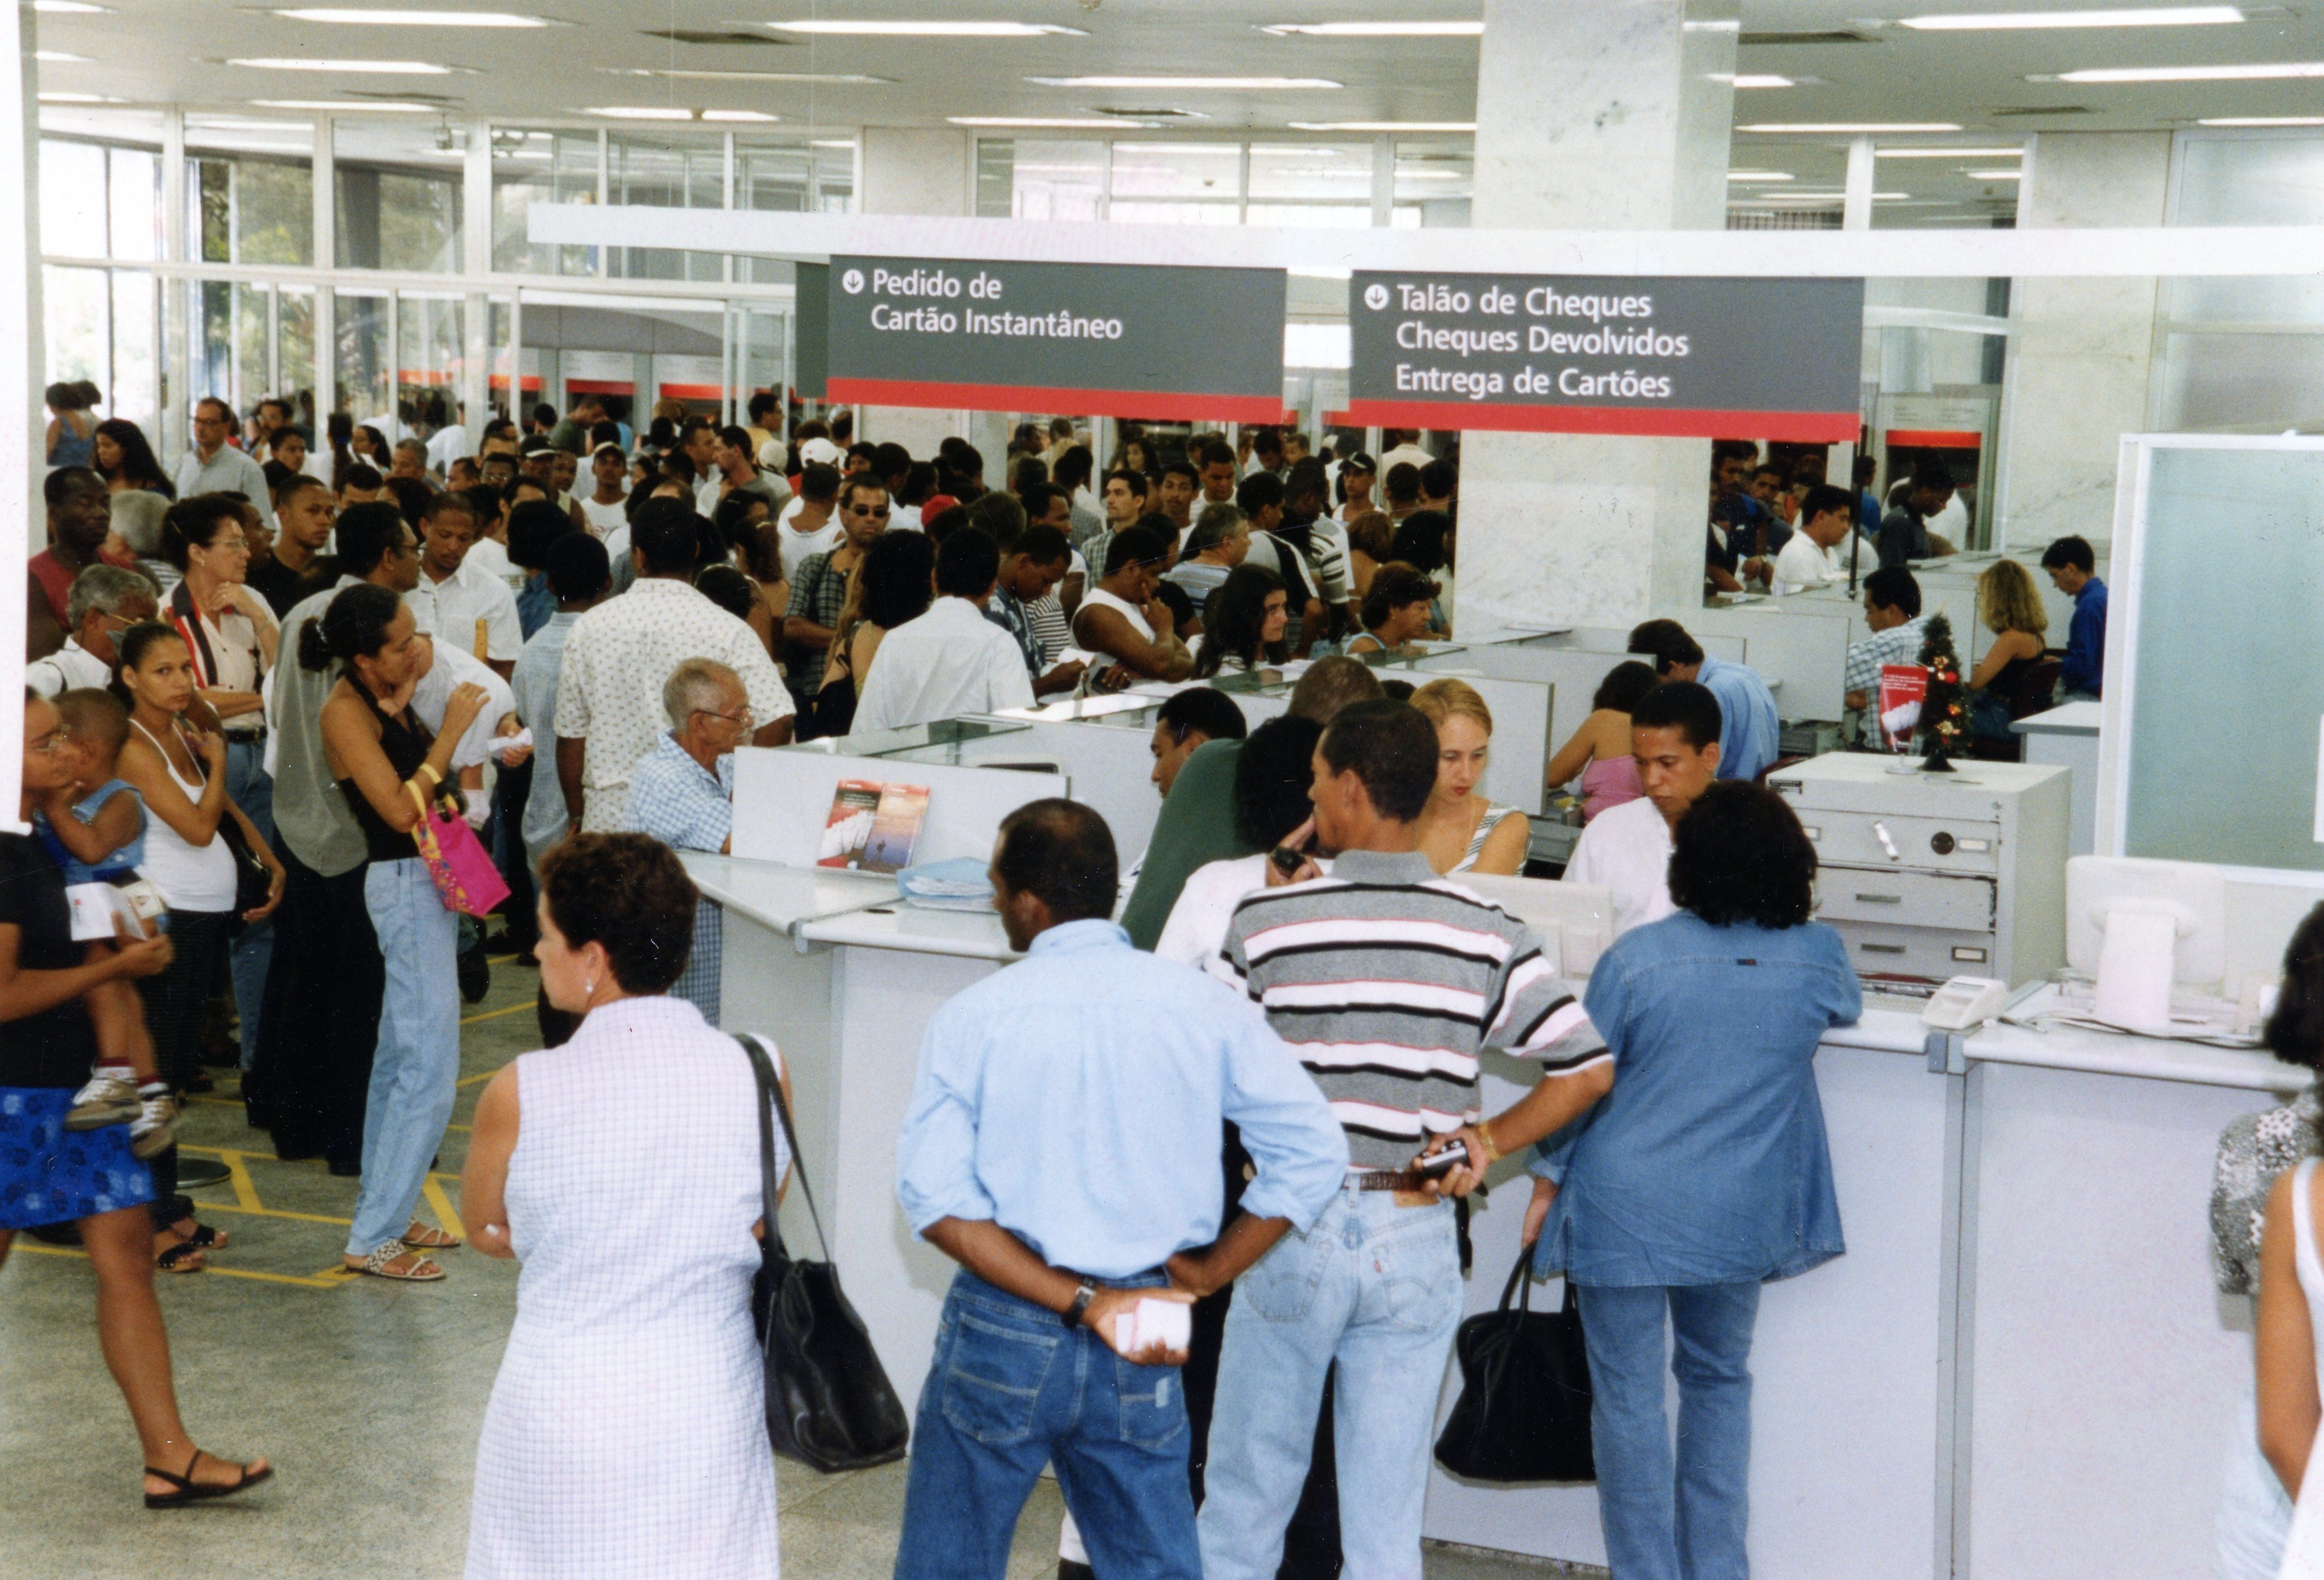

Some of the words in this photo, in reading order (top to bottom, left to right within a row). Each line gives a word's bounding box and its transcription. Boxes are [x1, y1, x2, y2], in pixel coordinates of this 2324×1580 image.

[873, 268, 961, 297] Pedido
[969, 272, 1002, 299] de
[871, 304, 957, 333] Cartão
[967, 309, 1123, 339] Instantâneo
[1397, 283, 1471, 313] Talão
[1480, 285, 1517, 315] de
[1525, 287, 1652, 323] Cheques
[1396, 320, 1519, 357] Cheques
[1529, 326, 1690, 357] Devolvidos
[1396, 363, 1504, 400] Entrega
[1513, 365, 1551, 395] de
[1559, 367, 1672, 398] Cartões
